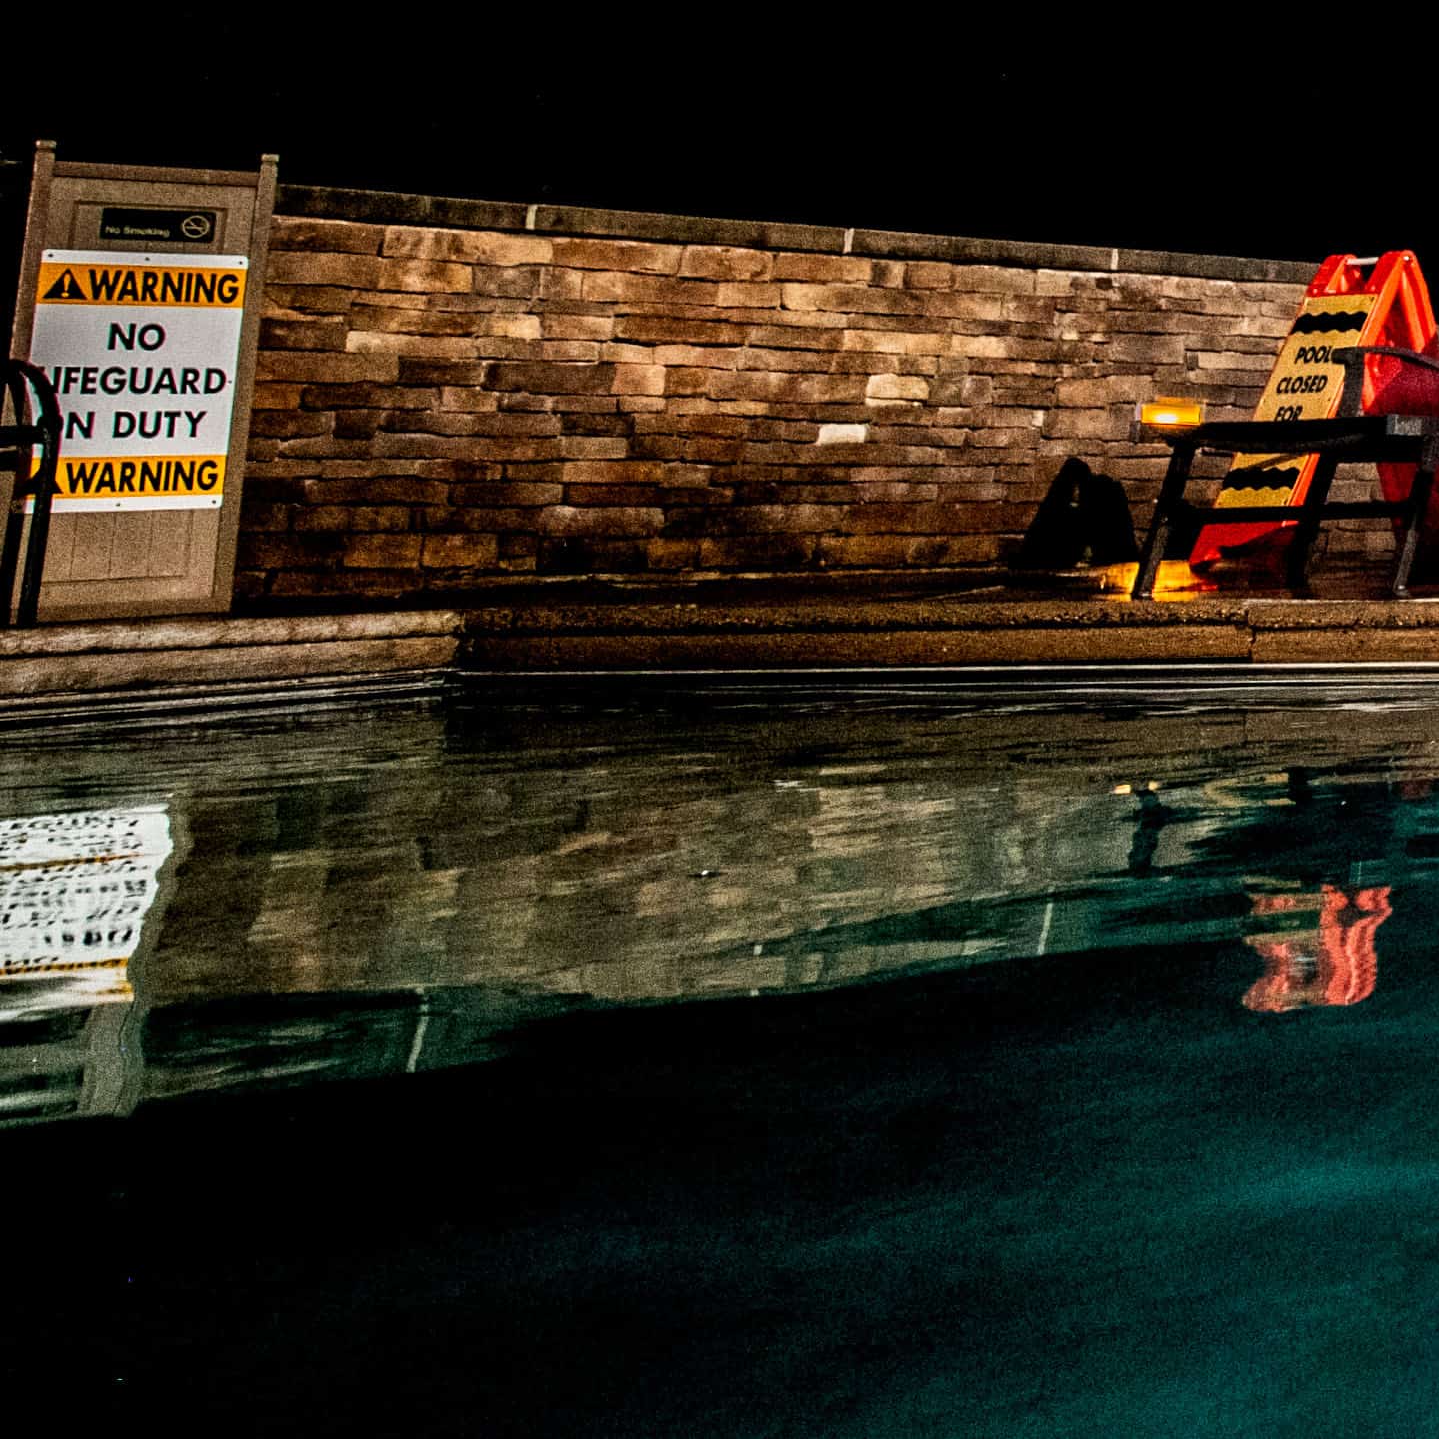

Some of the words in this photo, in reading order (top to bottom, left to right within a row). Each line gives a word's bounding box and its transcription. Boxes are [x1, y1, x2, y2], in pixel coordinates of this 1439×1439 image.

[88, 268, 240, 304] WARNING
[107, 322, 166, 352] NO
[50, 366, 227, 395] IFEGUARD
[1276, 375, 1329, 394] CLOSED
[65, 411, 96, 440] N
[112, 410, 208, 439] DUTY
[1274, 404, 1304, 421] FOR
[66, 459, 220, 494] WARNING
